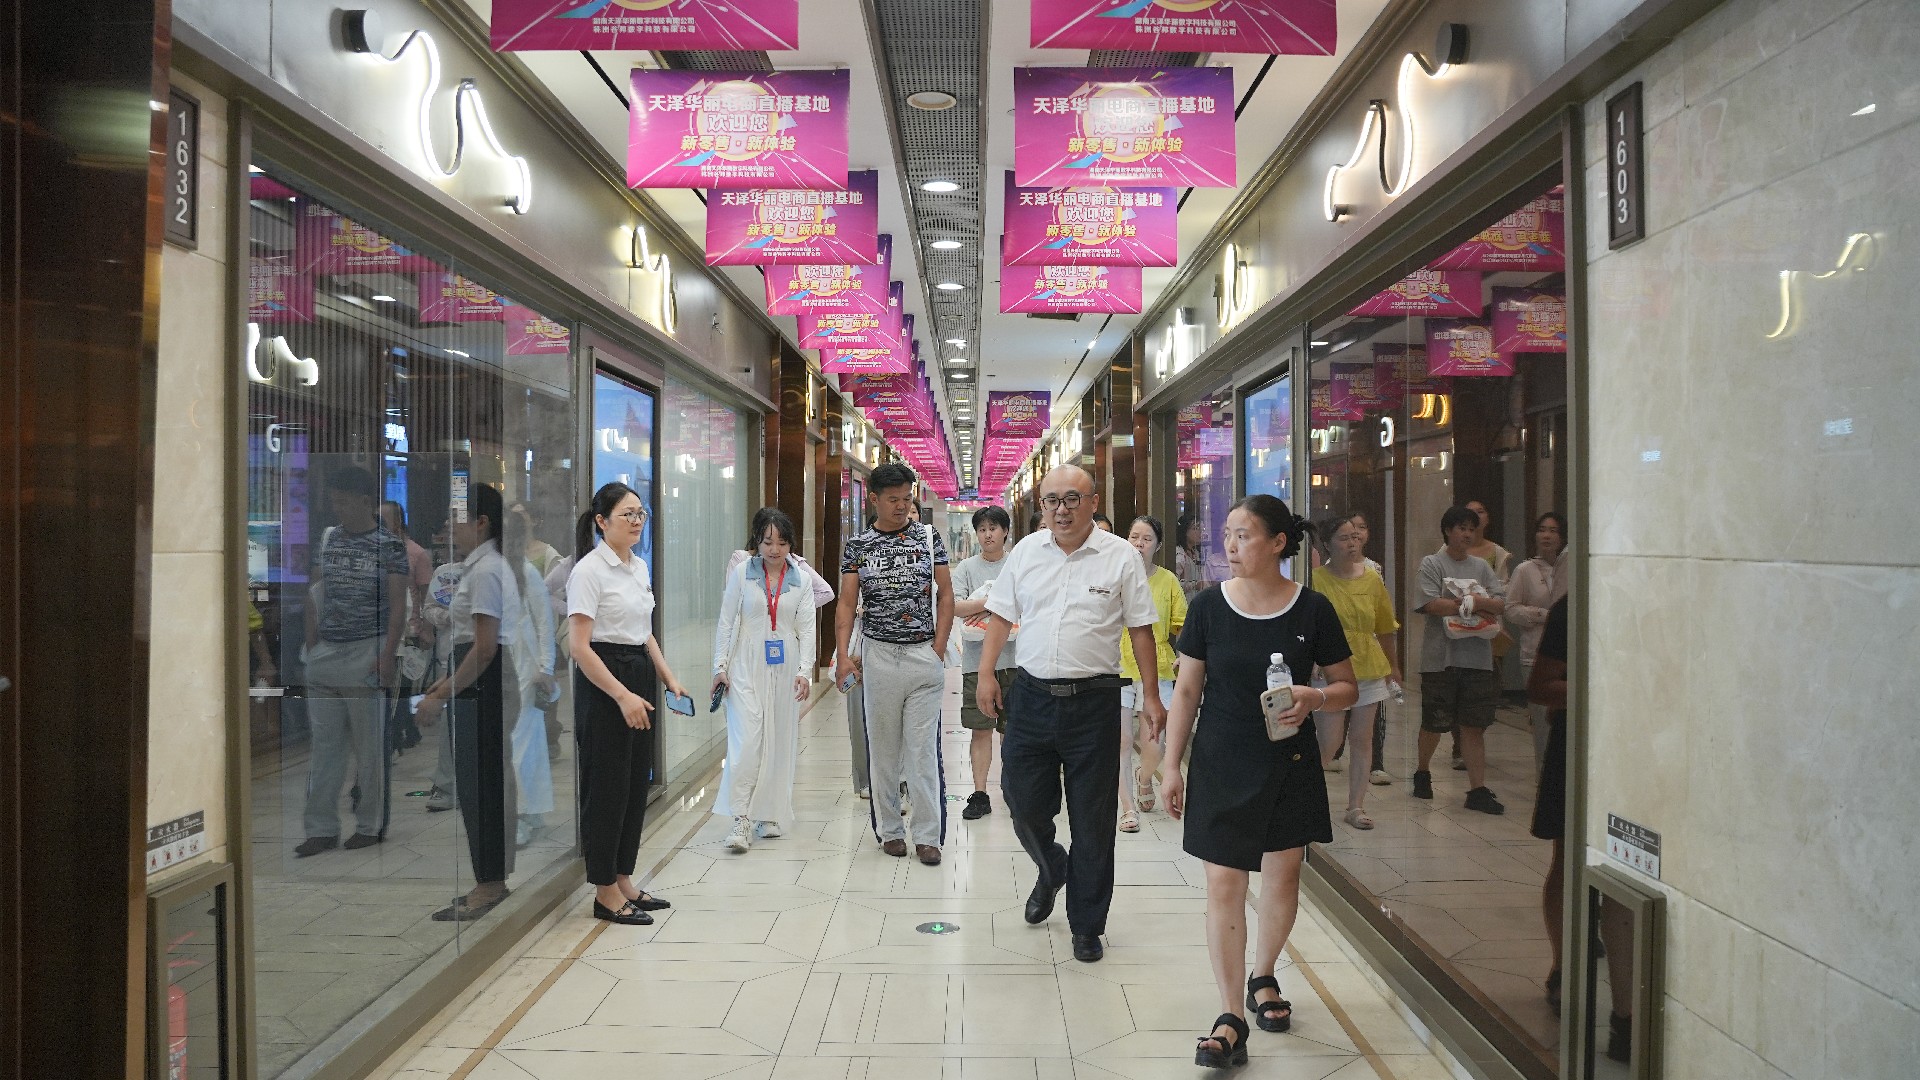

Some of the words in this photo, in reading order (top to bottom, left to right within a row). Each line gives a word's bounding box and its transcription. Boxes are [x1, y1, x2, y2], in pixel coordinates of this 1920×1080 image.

[648, 94, 831, 113] 天泽华丽电商直播基地
[1033, 96, 1216, 115] 天泽华丽电商直播基地
[708, 113, 768, 132] 欢迎您
[1093, 115, 1155, 135] 欢迎您
[175, 110, 188, 224] 1632
[1616, 110, 1628, 224] 1603
[722, 191, 863, 206] 天泽华丽电商直播基地
[1020, 192, 1162, 207] 天泽华丽电商直播基地
[768, 206, 816, 221] 欢迎您
[1066, 206, 1115, 222] 欢迎您
[863, 557, 888, 572] WE
